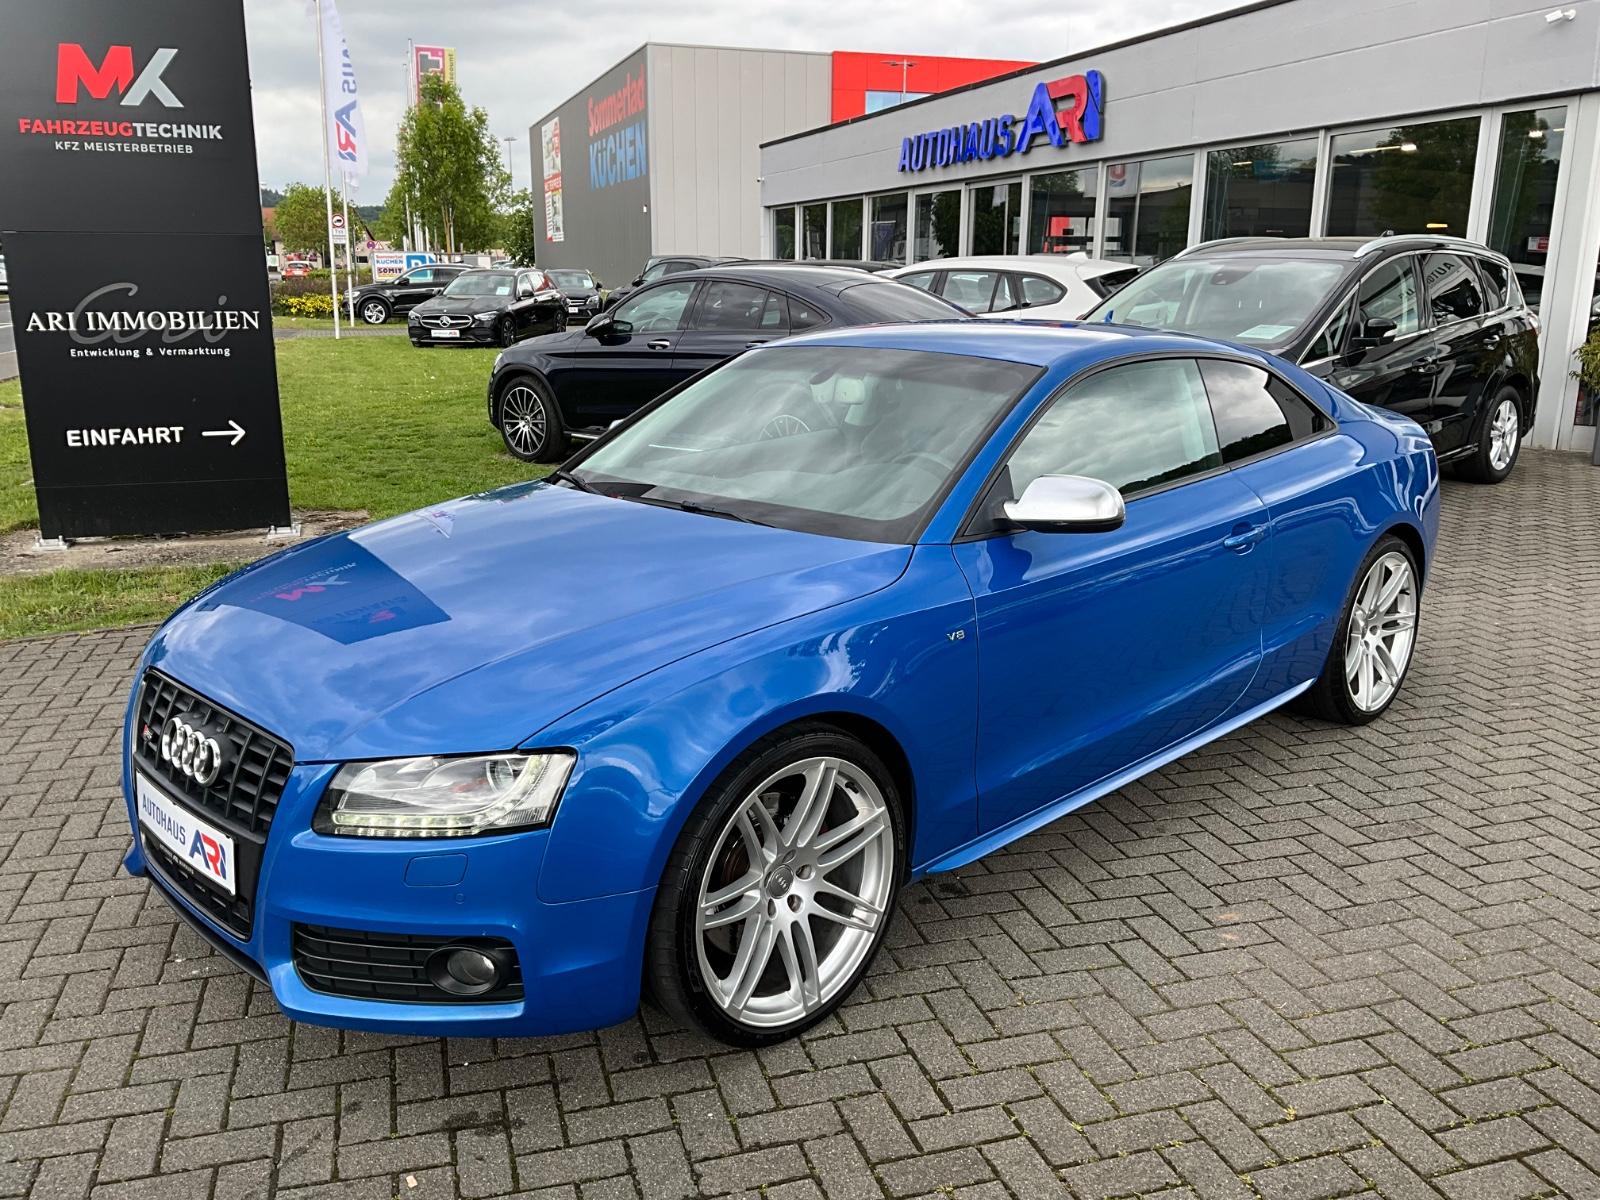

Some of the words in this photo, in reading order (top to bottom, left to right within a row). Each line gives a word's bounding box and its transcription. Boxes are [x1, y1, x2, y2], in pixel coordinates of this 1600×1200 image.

[56, 43, 184, 108] MK
[587, 64, 646, 137] Sommerlad
[18, 118, 223, 140] FAHRZEUGTECHNIK
[898, 114, 1016, 172] AUTOHAUS
[1016, 69, 1106, 153] ARI
[55, 140, 80, 151] KFZ
[84, 141, 194, 155] MEISTERBETRIEB
[588, 120, 647, 191] KÜCHEN
[26, 311, 77, 332] ARI
[85, 310, 260, 332] IMMOBILIEN
[70, 348, 140, 358] Entwicklung
[146, 347, 153, 356] &
[159, 347, 231, 357] Vermarktung
[66, 426, 184, 447] EINFAHRT
[946, 629, 965, 641] V8
[142, 793, 186, 846] AUTOHAUS
[189, 829, 227, 880] ARI
